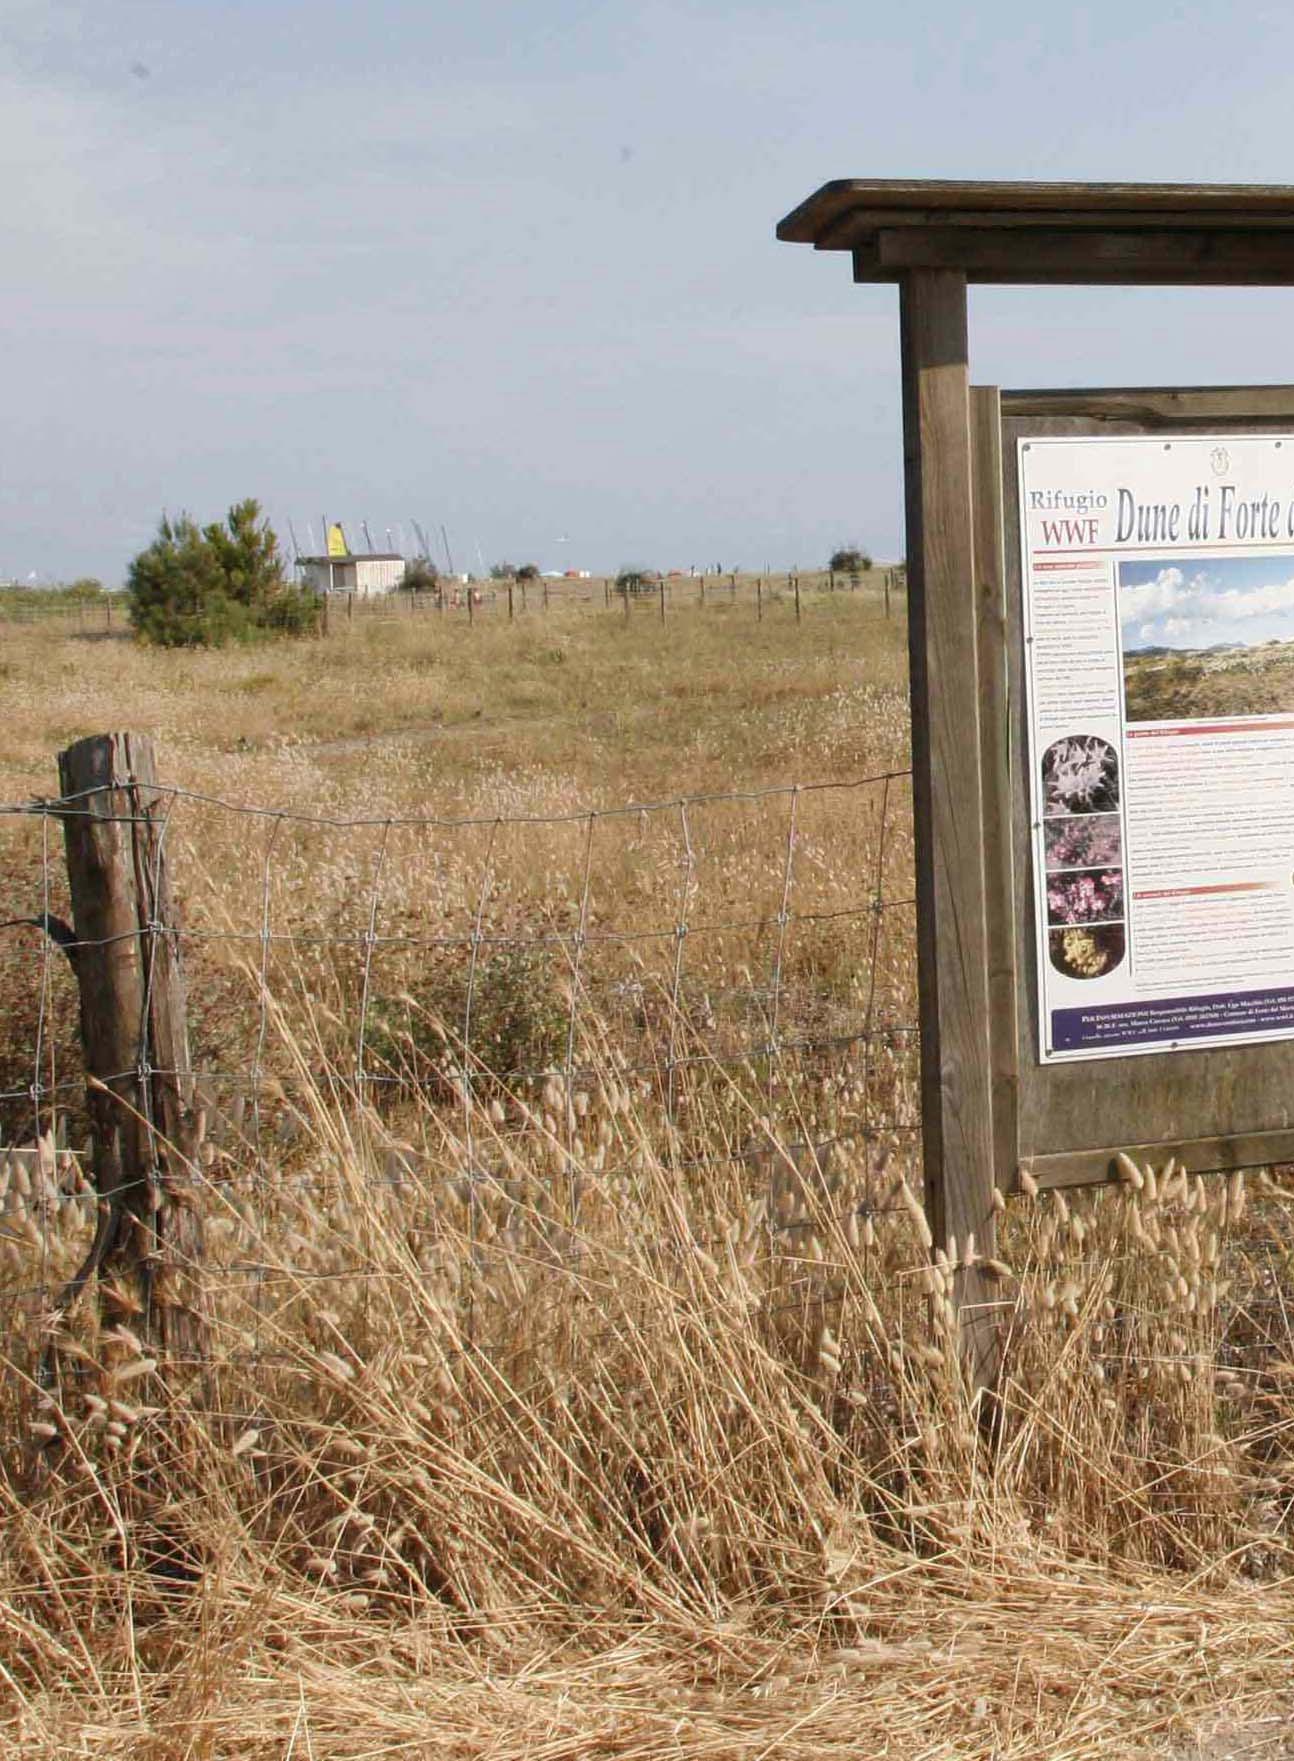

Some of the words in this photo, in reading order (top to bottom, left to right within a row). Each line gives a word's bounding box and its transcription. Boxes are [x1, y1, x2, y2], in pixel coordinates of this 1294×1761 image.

[1030, 489, 1108, 514] Rifugio
[1115, 488, 1180, 542] Dune
[1188, 485, 1209, 541] di
[1218, 486, 1280, 539] Forte
[1042, 519, 1099, 545] WWF
